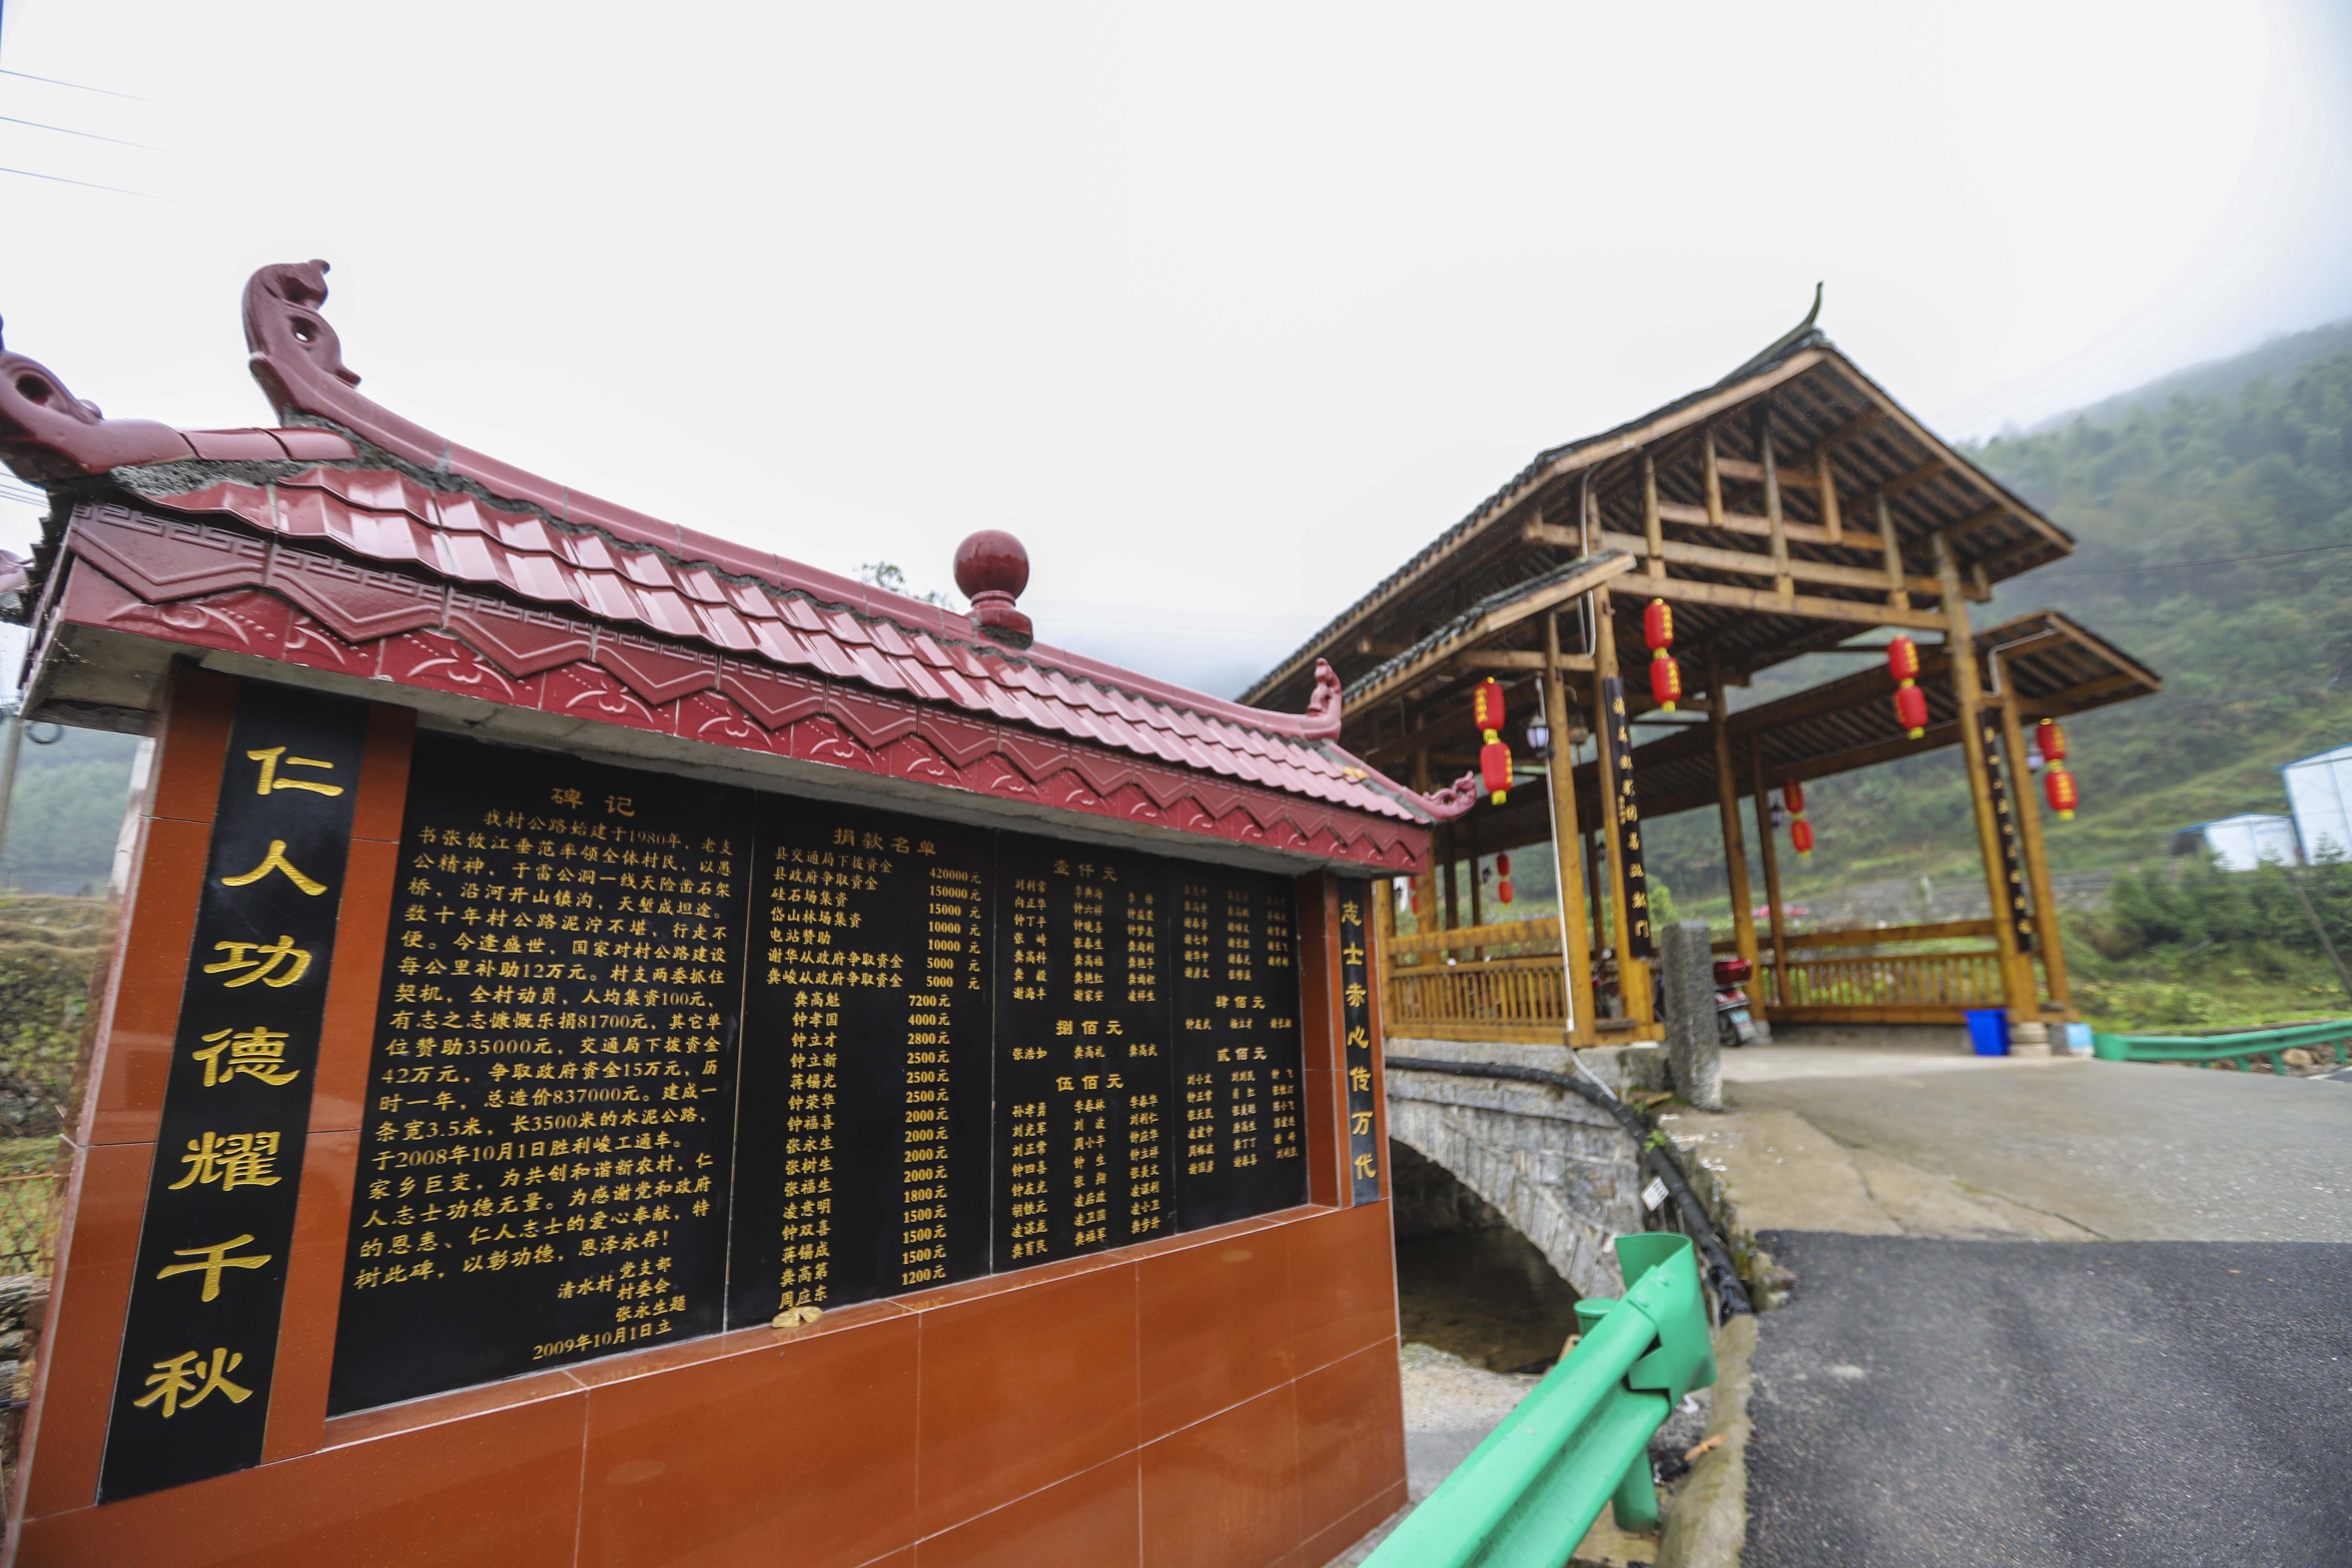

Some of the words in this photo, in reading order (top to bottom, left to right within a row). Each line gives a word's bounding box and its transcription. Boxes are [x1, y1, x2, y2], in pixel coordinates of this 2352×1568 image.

[551, 788, 635, 817] 碑记
[833, 828, 937, 856] 捐款名单
[775, 846, 893, 873] 县交通局下拨资金
[1054, 859, 1118, 882] 壹仟元
[773, 866, 878, 890] 县政府争取资金
[771, 887, 848, 908] 硅石场集资
[929, 902, 962, 916] 15000
[969, 906, 982, 919] 元
[1015, 896, 1047, 911] 向正华
[929, 921, 962, 934] 10000
[969, 923, 981, 937] 元
[1014, 914, 1046, 929] 钟丁平
[770, 926, 831, 945] 电站赞助
[928, 939, 961, 952] 10000
[969, 941, 981, 954] 元
[1073, 937, 1103, 950] 张春生
[767, 948, 904, 969] 谢华从政府争取资金
[926, 957, 954, 969] 5000
[968, 959, 981, 972] 元
[1014, 949, 1047, 965] 龚高科
[1074, 953, 1104, 967] 龚高福
[926, 975, 954, 988] 5000
[968, 977, 980, 990] 元
[908, 994, 951, 1007] 7200元
[1013, 986, 1046, 1000] 谢海丰
[1073, 989, 1104, 1002] 谢家安
[1215, 995, 1265, 1009] 肆佰元
[792, 1011, 838, 1028] 钟孝国
[908, 1012, 951, 1026] 4000元
[1055, 1020, 1124, 1036] 捌佰元
[791, 1032, 838, 1049] 钟立才
[907, 1031, 951, 1045] 2800元
[1340, 899, 1377, 1180] 志士赤心传万代
[790, 1052, 837, 1069] 钟立新
[906, 1050, 950, 1064] 2500元
[1012, 1047, 1048, 1061] 张浩如
[1217, 1046, 1267, 1062] 贰佰元
[132, 746, 345, 1418] 仁人功德耀千秋
[789, 1073, 837, 1090] 蒋锡光
[906, 1069, 950, 1084] 2500元
[1055, 1073, 1124, 1092] 伍佰元
[788, 1093, 836, 1111] 钟荣华
[905, 1087, 949, 1103] 2500元
[1012, 1101, 1046, 1118] 孙孝勇
[1075, 1098, 1106, 1114] 李春林
[787, 1113, 835, 1133] 钟福喜
[905, 1107, 949, 1123] 2000元
[1012, 1121, 1047, 1138] 刘光军
[786, 1135, 834, 1155] 张永生
[904, 1126, 949, 1143] 2000元
[1012, 1140, 1047, 1157] 刘正常
[1073, 1135, 1106, 1151] 周小平
[785, 1156, 833, 1176] 张树生
[904, 1145, 949, 1163] 2000元
[1011, 1160, 1047, 1178] 钟四喜
[784, 1177, 833, 1197] 张福生
[903, 1165, 948, 1183] 2000元
[1011, 1180, 1048, 1197] 钟友光
[904, 1184, 948, 1203] 1800元
[781, 1219, 831, 1241] 钟双喜
[903, 1204, 947, 1223] 1500元
[1073, 1208, 1106, 1227] 凌卫国
[1130, 1199, 1161, 1216] 凌小卫
[781, 1241, 830, 1264] 蒋锡成
[903, 1224, 947, 1244] 1500元
[902, 1244, 947, 1265] 1500元
[619, 1256, 672, 1280] 党支部
[557, 1274, 615, 1299] 清水村
[616, 1277, 671, 1301] 村委会
[779, 1285, 828, 1309] 周应东
[902, 1264, 946, 1286] 1200元
[615, 1294, 686, 1323] 张永生题
[533, 1318, 672, 1360] 2009年10月1日立
